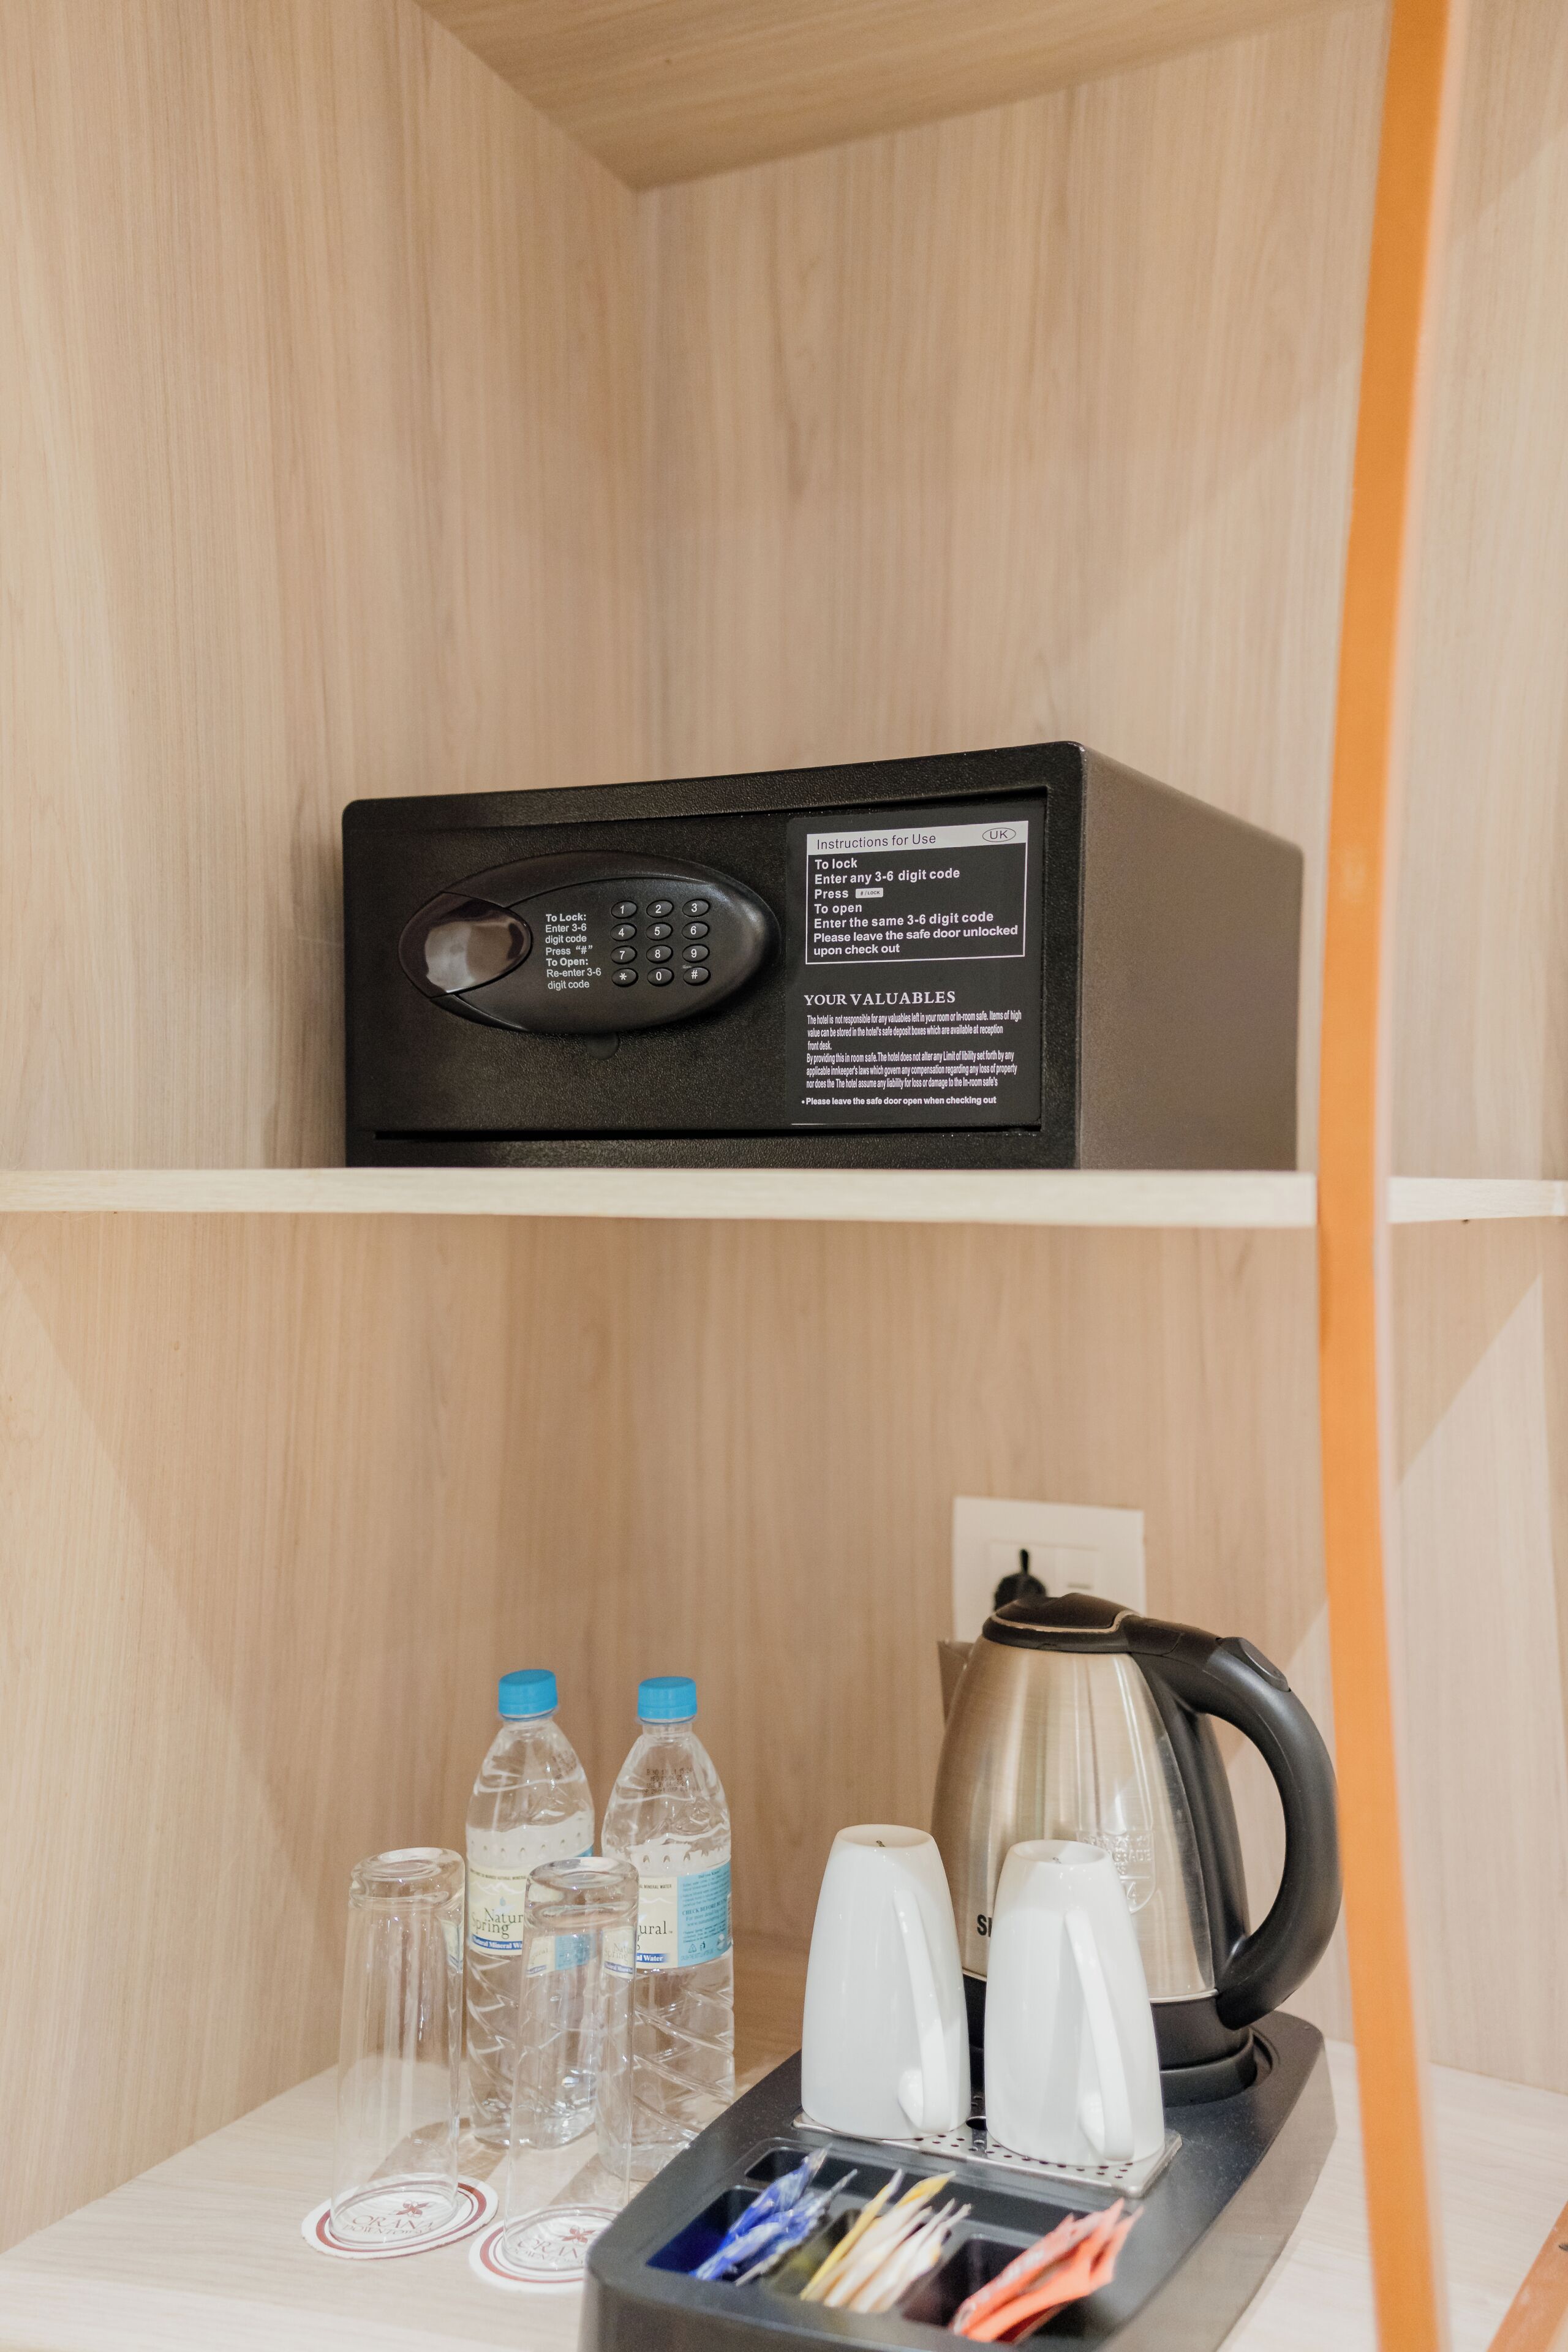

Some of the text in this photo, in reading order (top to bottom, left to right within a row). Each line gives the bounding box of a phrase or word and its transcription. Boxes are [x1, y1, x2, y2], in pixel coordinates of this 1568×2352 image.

[989, 830, 1008, 839] UK
[816, 834, 937, 850] Instructions for Use
[815, 858, 858, 870] To lock
[815, 868, 960, 885] Enter any 3-6 digit code
[815, 888, 849, 900] Press
[620, 905, 625, 914] 1
[691, 903, 697, 912] 3
[814, 903, 862, 915] To open
[560, 913, 587, 922] Lock:
[815, 911, 994, 929] Enter the same 3-6 digit code
[545, 924, 587, 933] Enter 3-6
[619, 928, 625, 937] 4
[691, 926, 697, 935] 6
[545, 933, 587, 944] digit code
[813, 925, 1018, 943] Please leave the safe door unlocked
[546, 946, 571, 955] Press
[620, 951, 625, 959] 7
[655, 949, 661, 958] 8
[691, 949, 697, 958] 9
[813, 943, 900, 957] upon check out
[560, 958, 588, 967] Open:
[546, 968, 601, 978] Re-enter 3-6
[656, 971, 662, 981] 0
[691, 970, 698, 979] #
[548, 980, 589, 990] digit code
[804, 991, 956, 1006] YOUR VALUABLES
[807, 1016, 816, 1025] The
[817, 1015, 829, 1024] hotel
[843, 1014, 870, 1025] responsible
[888, 1012, 911, 1022] valuables
[925, 1013, 937, 1024] your
[937, 1013, 949, 1022] room
[956, 1012, 975, 1021] In-room
[976, 1011, 988, 1020] safe.
[990, 1011, 1003, 1020] Items
[1004, 1010, 1009, 1020] of
[1011, 1009, 1021, 1022] high
[808, 1028, 820, 1038] value
[830, 1028, 835, 1036] be
[837, 1027, 851, 1037] stored
[866, 1027, 881, 1036] hotel's
[883, 1026, 893, 1036] safe
[894, 1026, 911, 1038] deposit
[911, 1024, 926, 1035] boxes
[927, 1025, 940, 1035] which
[951, 1024, 973, 1034] available
[973, 1025, 979, 1034] at
[979, 1024, 1003, 1036] reception
[808, 1040, 832, 1050] front desk.
[807, 1054, 813, 1065] By
[813, 1053, 835, 1065] providing
[888, 1052, 900, 1061] hotel
[900, 1052, 912, 1061] does
[933, 1053, 943, 1063] any
[943, 1051, 955, 1061] Limit
[956, 1050, 961, 1060] of
[986, 1050, 997, 1060] forth
[998, 1050, 1004, 1062] by
[1005, 1052, 1014, 1061] any
[807, 1063, 1017, 1077] applicable innkeeper's laws which govern any compensation regarding any loss of property
[815, 1079, 826, 1088] does
[835, 1079, 845, 1088] The
[845, 1078, 857, 1088] hotel
[877, 1080, 886, 1090] any
[887, 1078, 903, 1090] liability
[911, 1077, 921, 1087] loss
[929, 1078, 948, 1089] damage
[963, 1077, 982, 1087] In-room
[983, 1076, 998, 1087] safe's
[946, 1096, 981, 1105] checking
[484, 1908, 524, 1923] Natur
[471, 1912, 510, 1940] Spring
